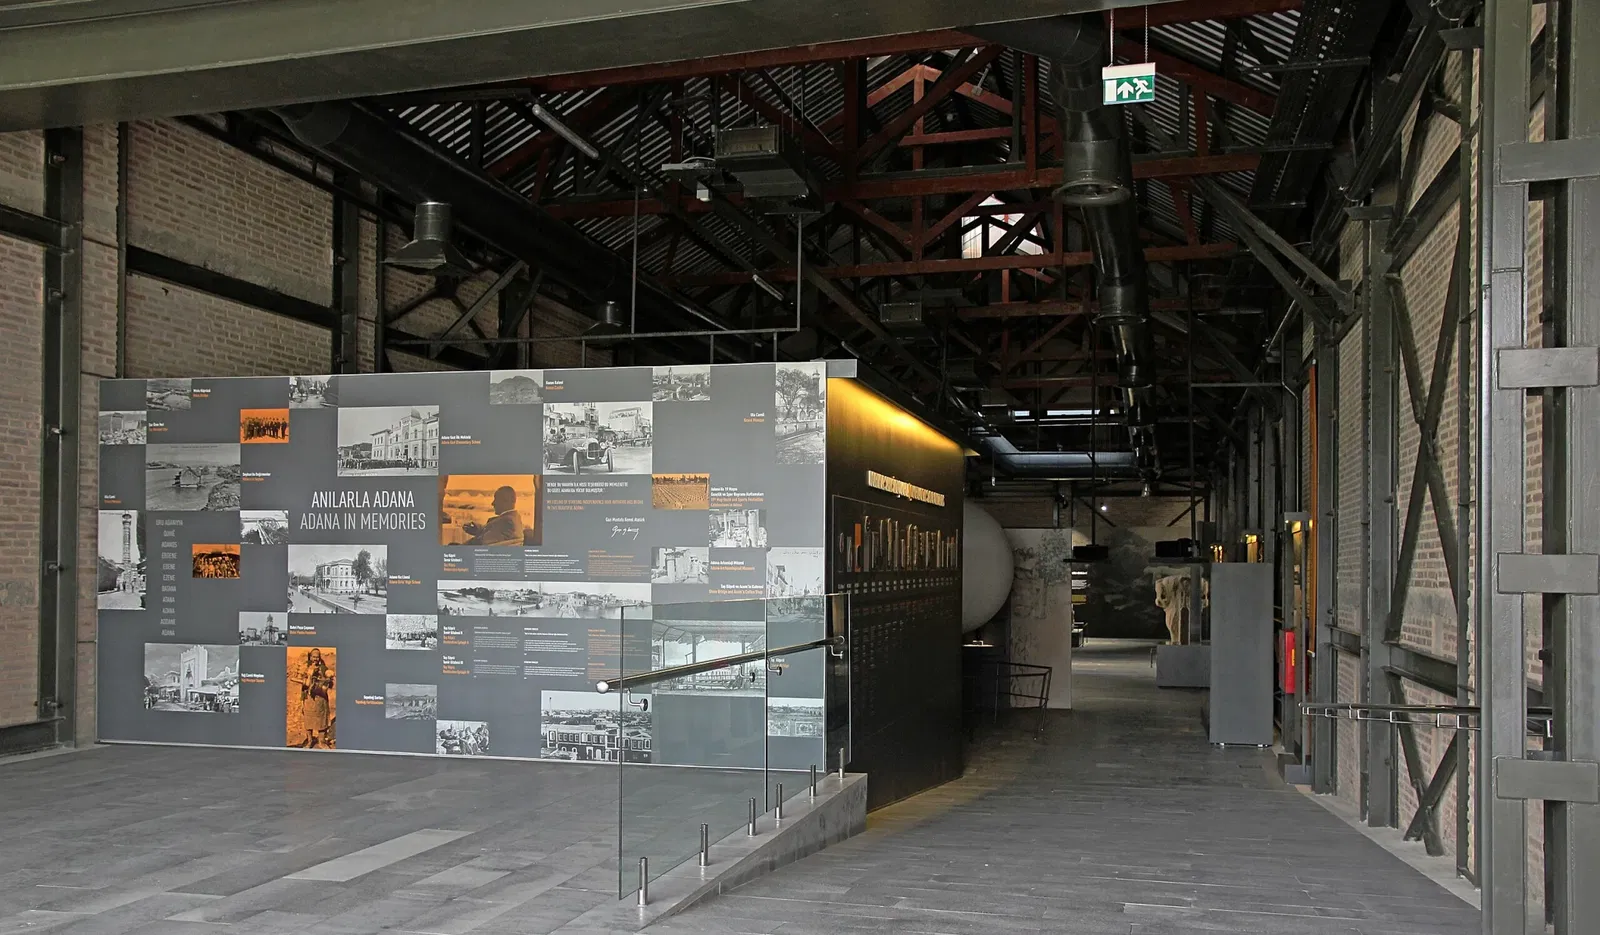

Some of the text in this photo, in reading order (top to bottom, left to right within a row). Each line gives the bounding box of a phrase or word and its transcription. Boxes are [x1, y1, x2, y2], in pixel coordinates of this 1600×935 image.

[312, 490, 415, 508] ANILARLA ADANA
[300, 512, 426, 530] ADANA IN MEMORIES
